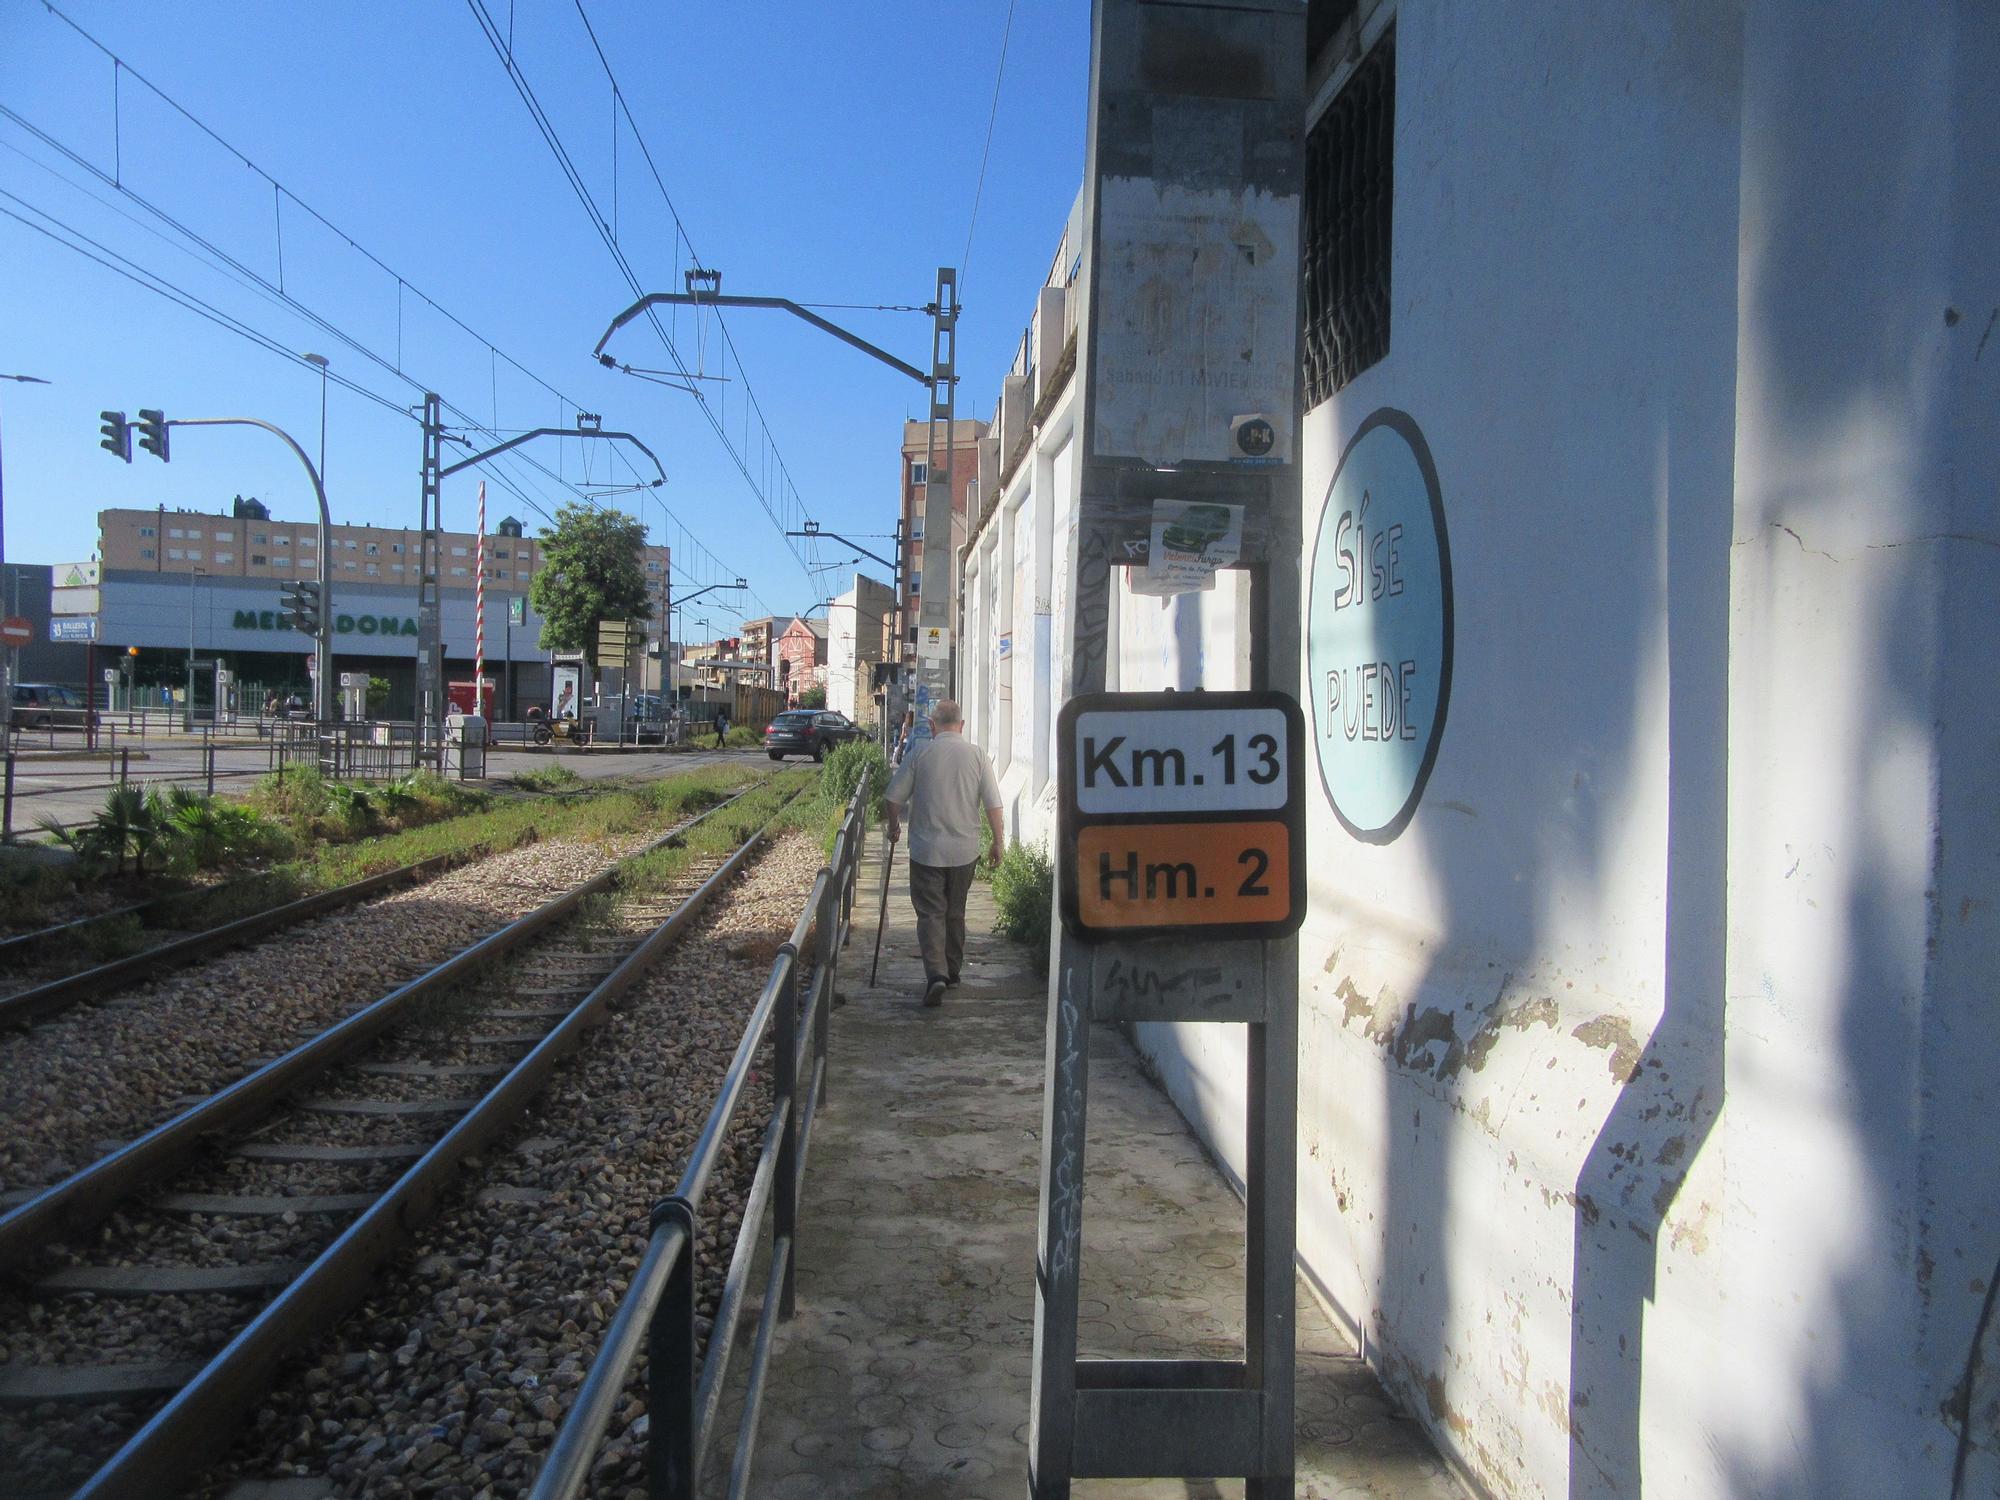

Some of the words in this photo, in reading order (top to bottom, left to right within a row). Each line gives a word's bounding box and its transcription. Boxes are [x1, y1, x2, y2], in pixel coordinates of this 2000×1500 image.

[1370, 522, 1404, 601] SE
[1326, 659, 1416, 743] PUEDE
[1098, 850, 1216, 901] Hm.
[1236, 847, 1270, 898] 2
